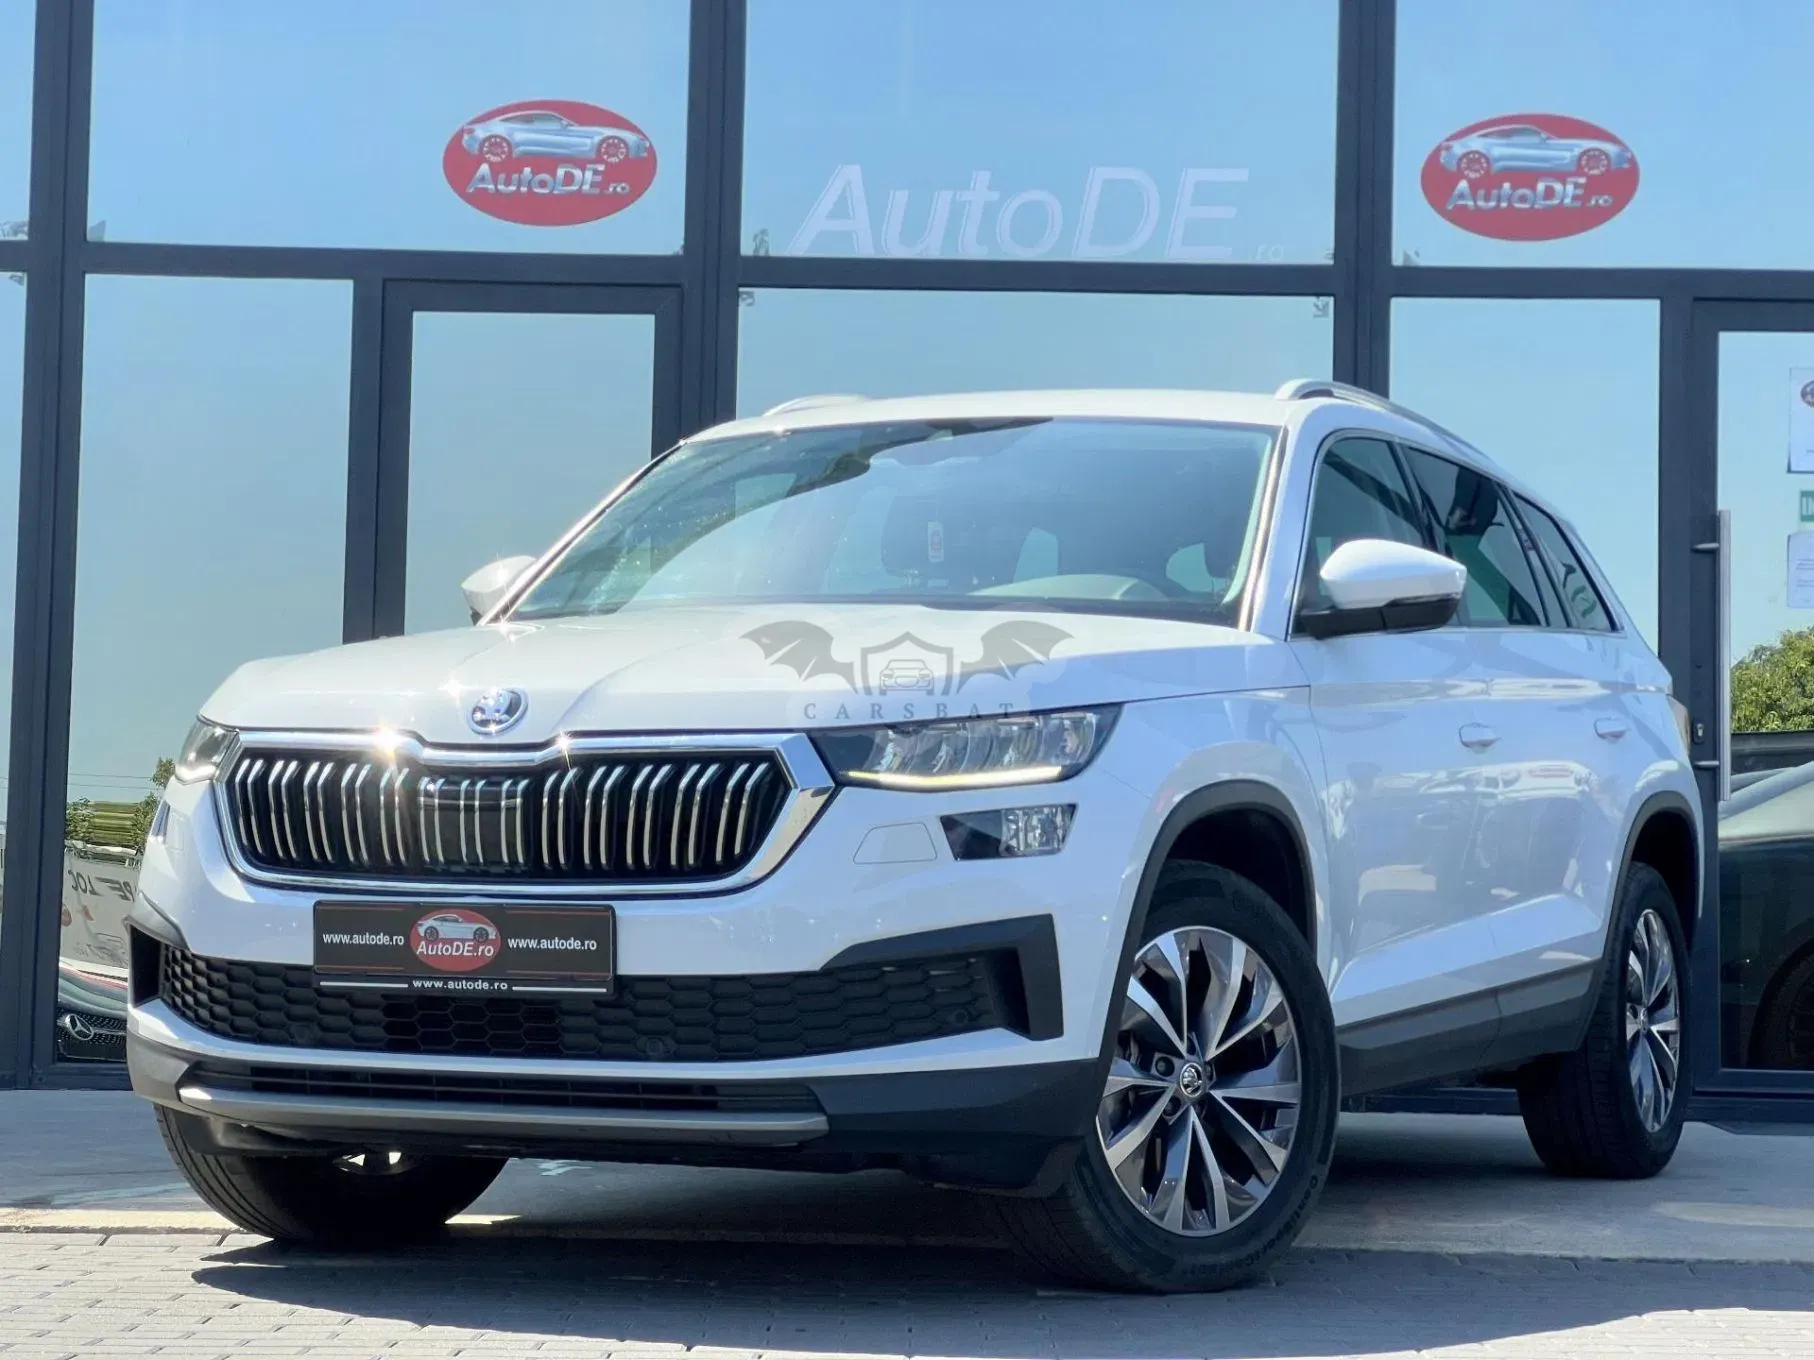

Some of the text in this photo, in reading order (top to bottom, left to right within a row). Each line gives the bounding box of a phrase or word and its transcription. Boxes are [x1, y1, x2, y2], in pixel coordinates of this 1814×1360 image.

[322, 932, 405, 946] www.autode.ro
[507, 936, 597, 951] www.autode.ro
[416, 940, 495, 958] AutoDE.ro
[412, 979, 509, 991] www.autode.ro
